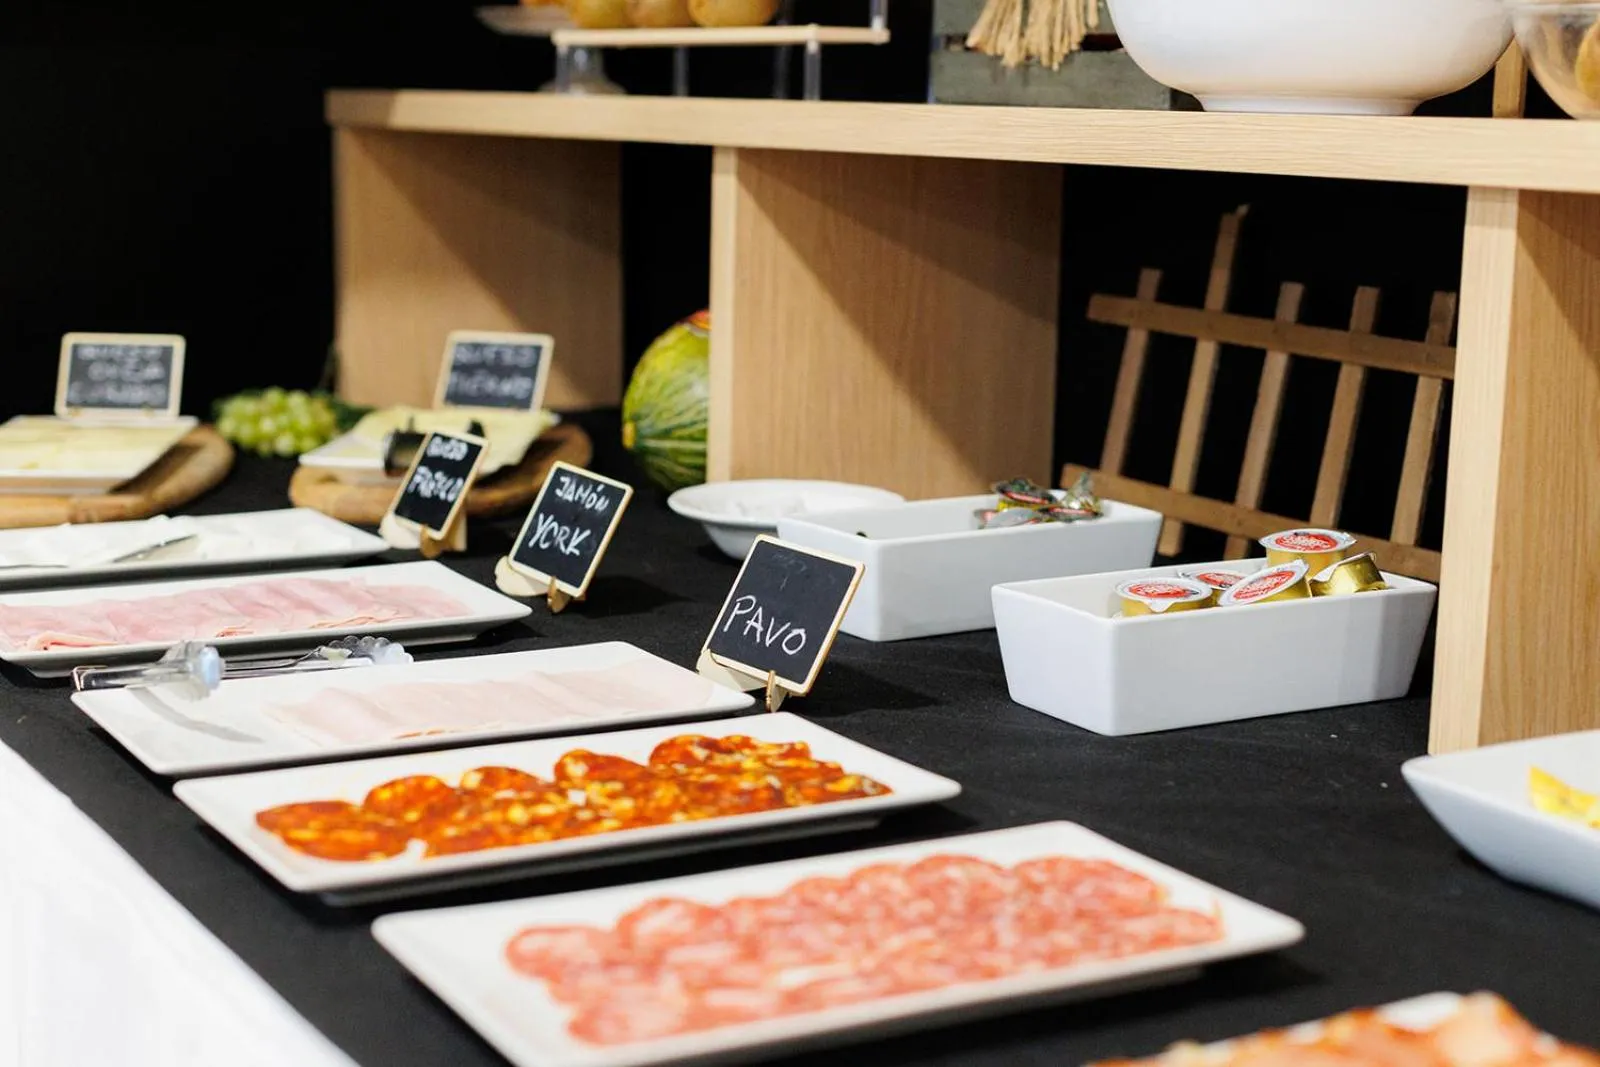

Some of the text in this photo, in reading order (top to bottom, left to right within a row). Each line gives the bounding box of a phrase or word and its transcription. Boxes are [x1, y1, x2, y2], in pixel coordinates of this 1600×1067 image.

[555, 476, 610, 511] JAMÓN
[528, 512, 592, 556] YORK
[723, 595, 808, 656] PAVO
